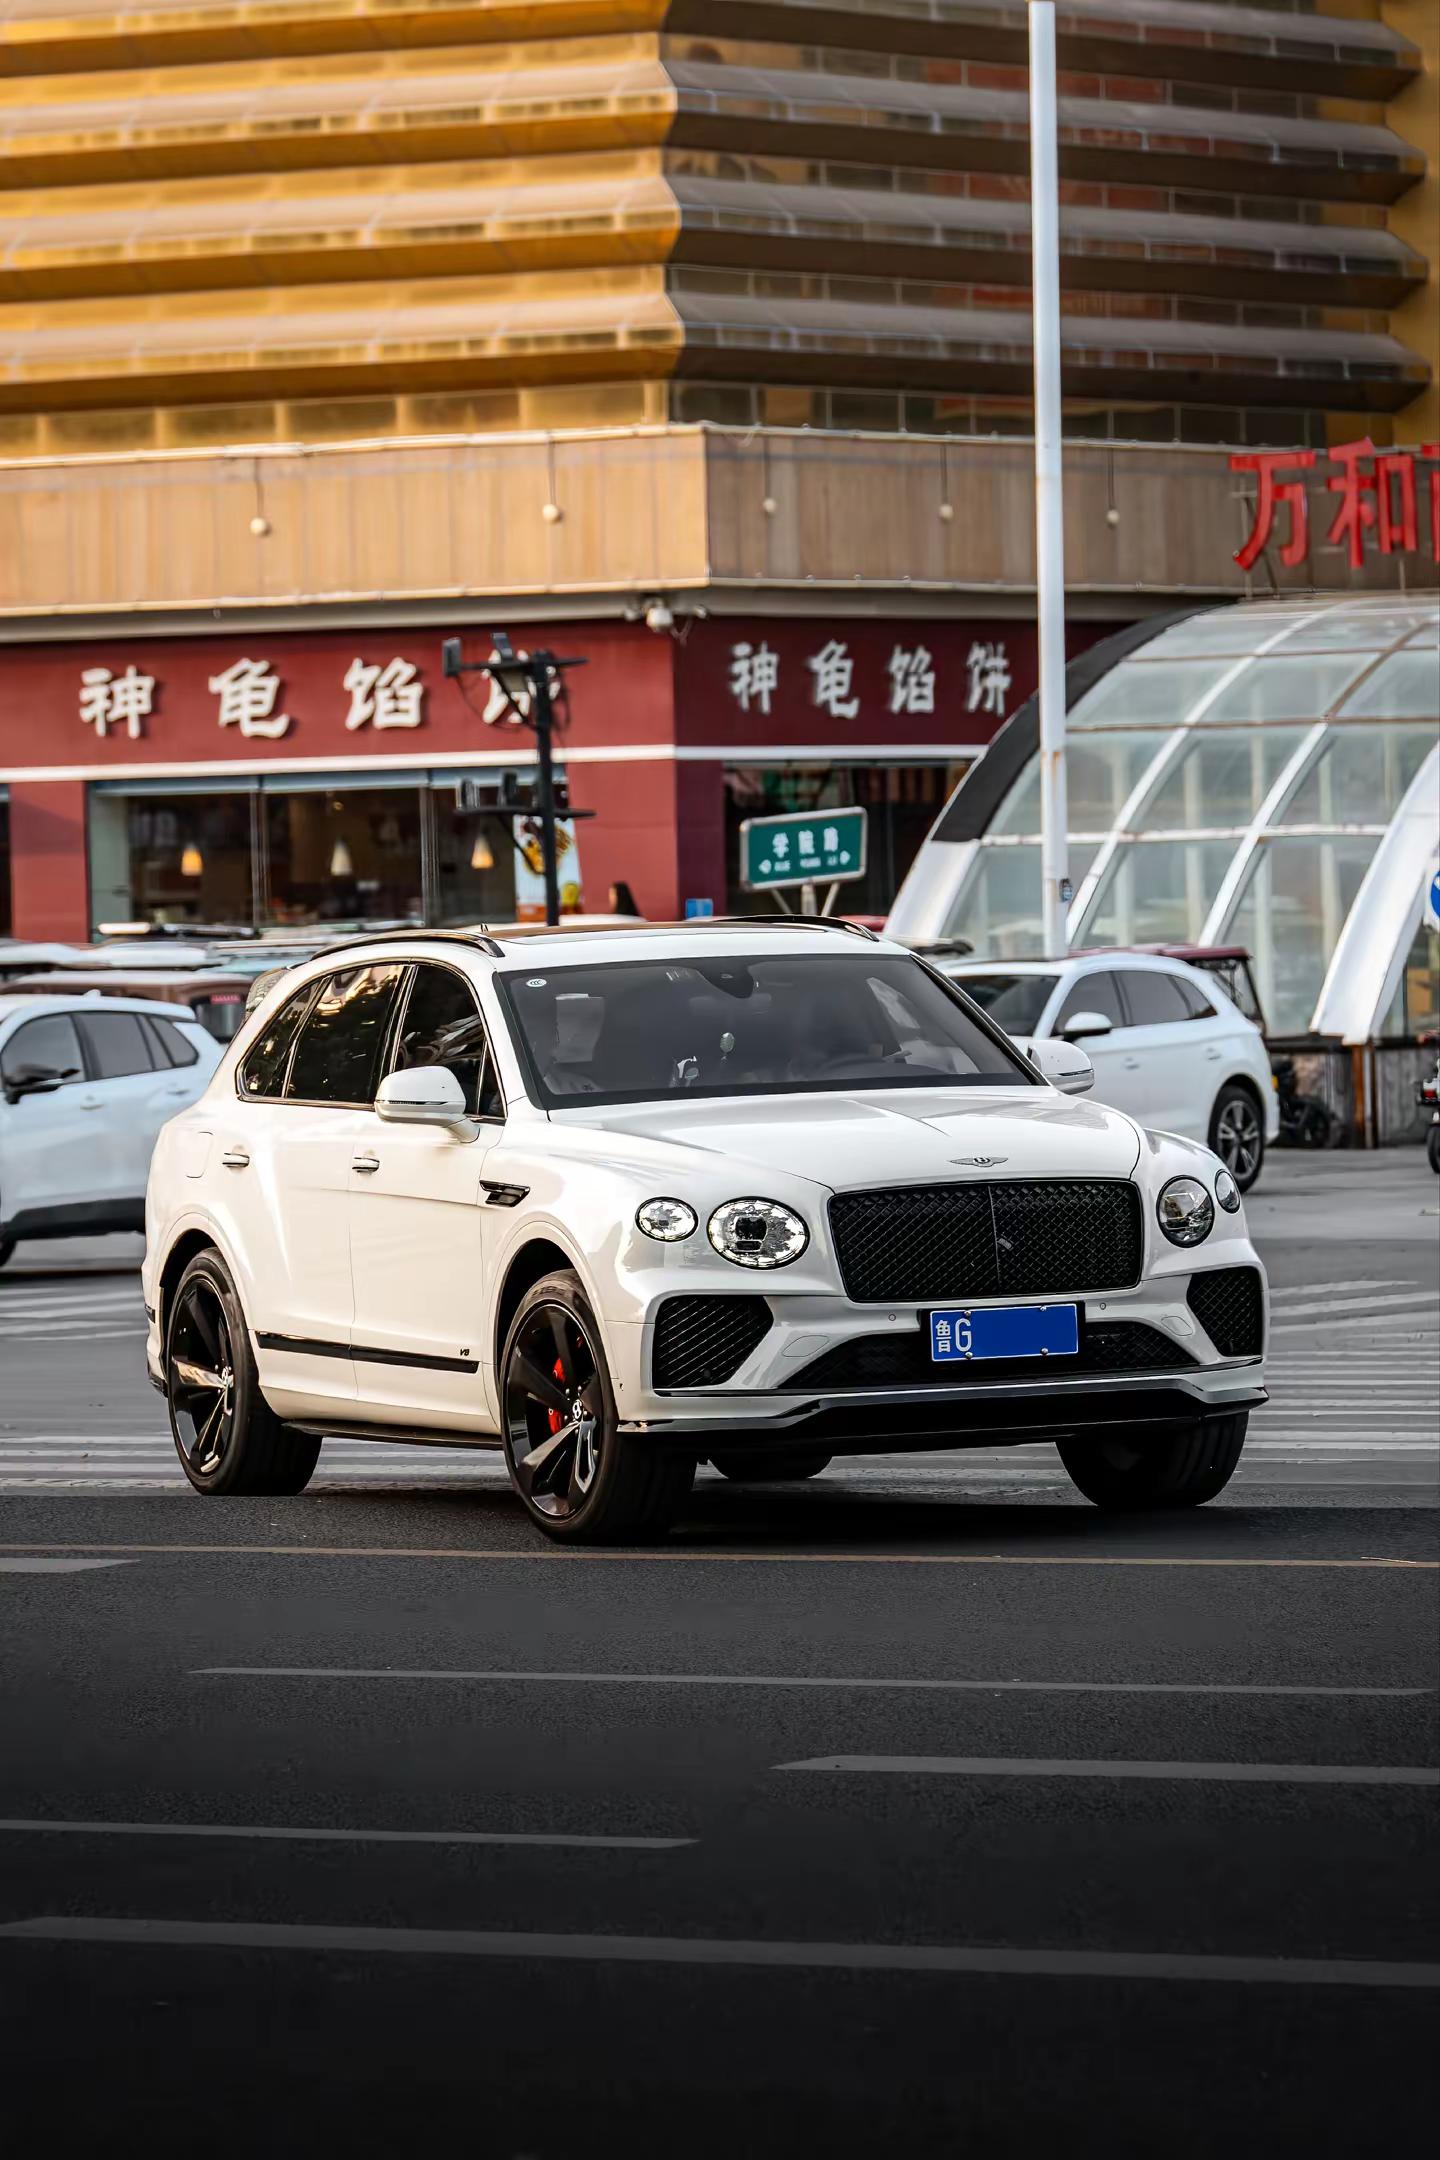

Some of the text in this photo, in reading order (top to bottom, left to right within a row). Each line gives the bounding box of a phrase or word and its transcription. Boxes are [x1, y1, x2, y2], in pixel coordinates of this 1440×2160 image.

[1229, 436, 1440, 570] 万和
[729, 639, 1012, 719] 神龟馅饼
[459, 1348, 470, 1356] V8
[935, 1317, 973, 1353] 鲁G
